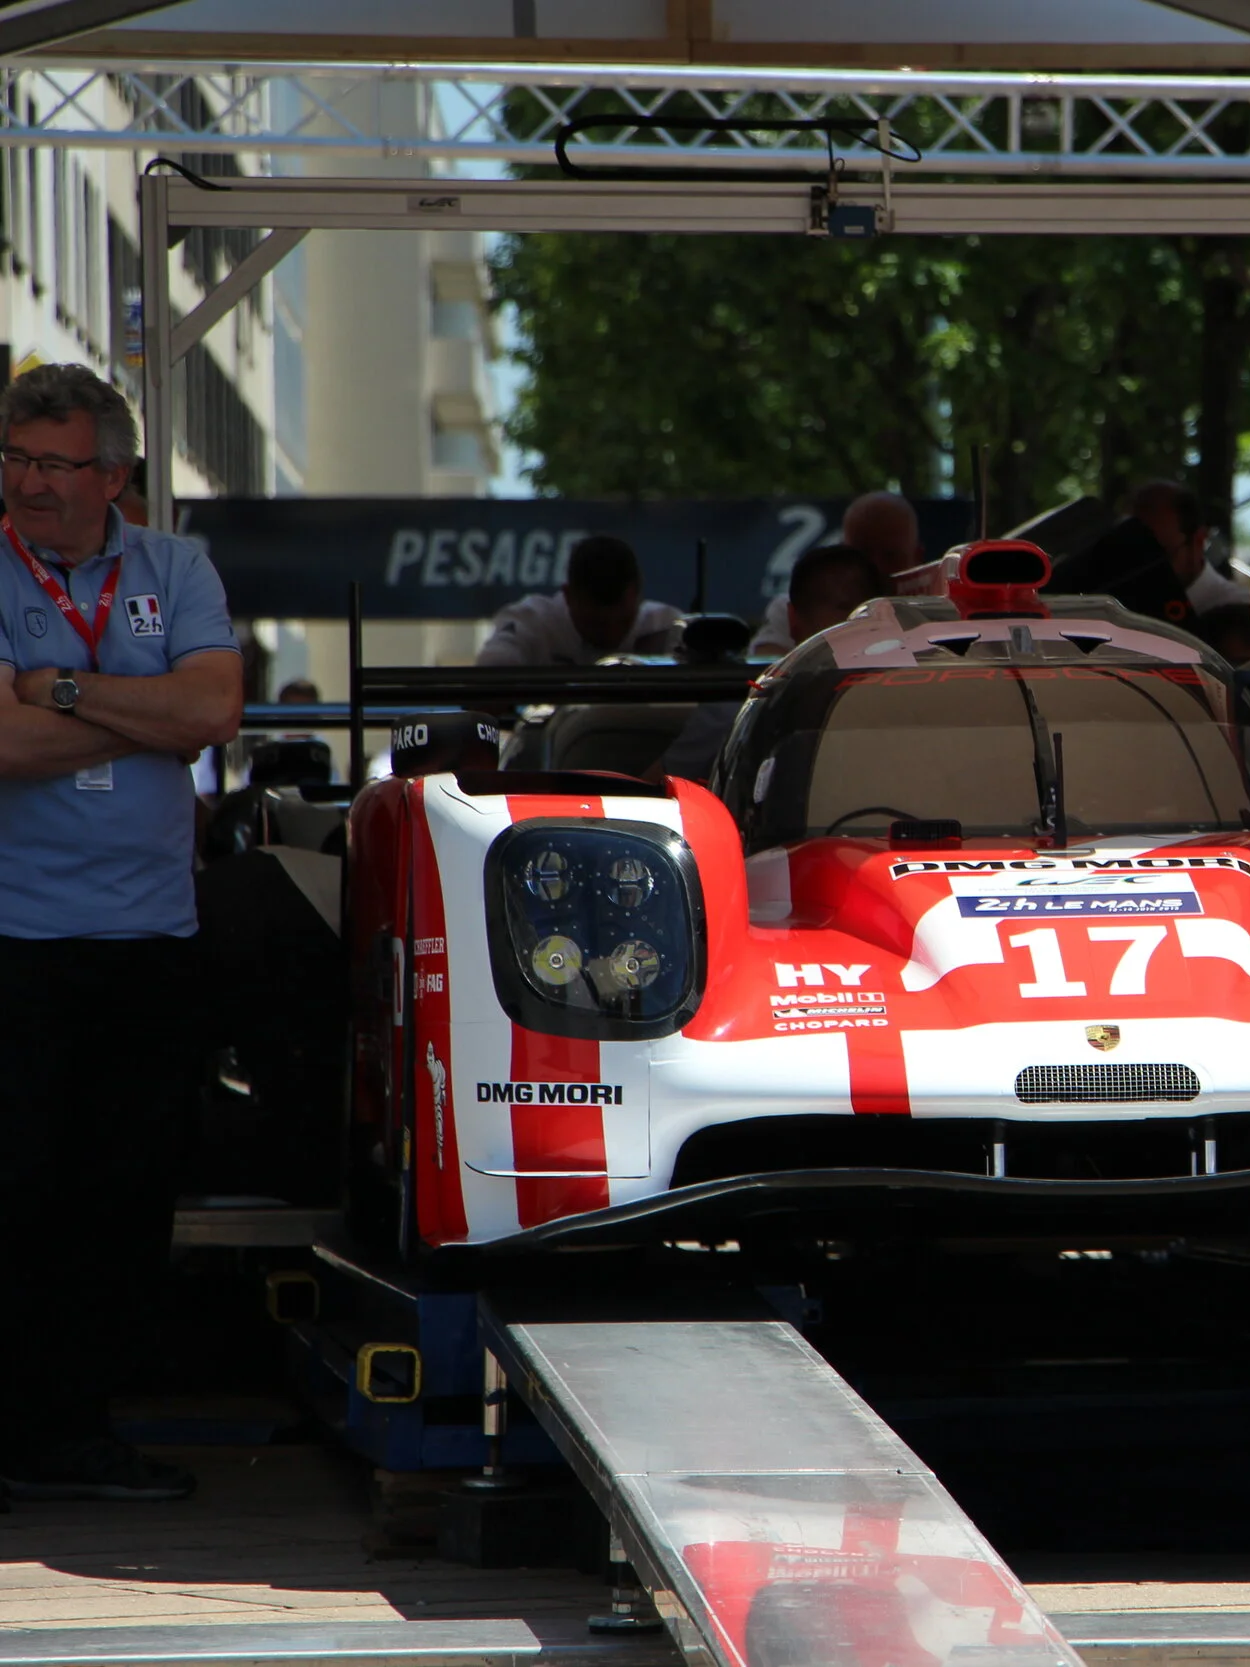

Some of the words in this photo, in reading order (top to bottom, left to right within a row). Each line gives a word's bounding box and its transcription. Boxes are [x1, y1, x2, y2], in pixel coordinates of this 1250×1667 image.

[834, 667, 1210, 691] PORSCHE
[892, 861, 1056, 879] DMG
[1045, 900, 1084, 911] LE
[1090, 898, 1183, 910] MANS
[1009, 925, 1168, 998] 17
[426, 973, 443, 992] FAG
[774, 962, 872, 987] HY
[770, 992, 853, 1006] Mobil
[774, 1019, 889, 1031] CHOPARD
[477, 1082, 534, 1103] DMG
[538, 1084, 623, 1105] MORI
